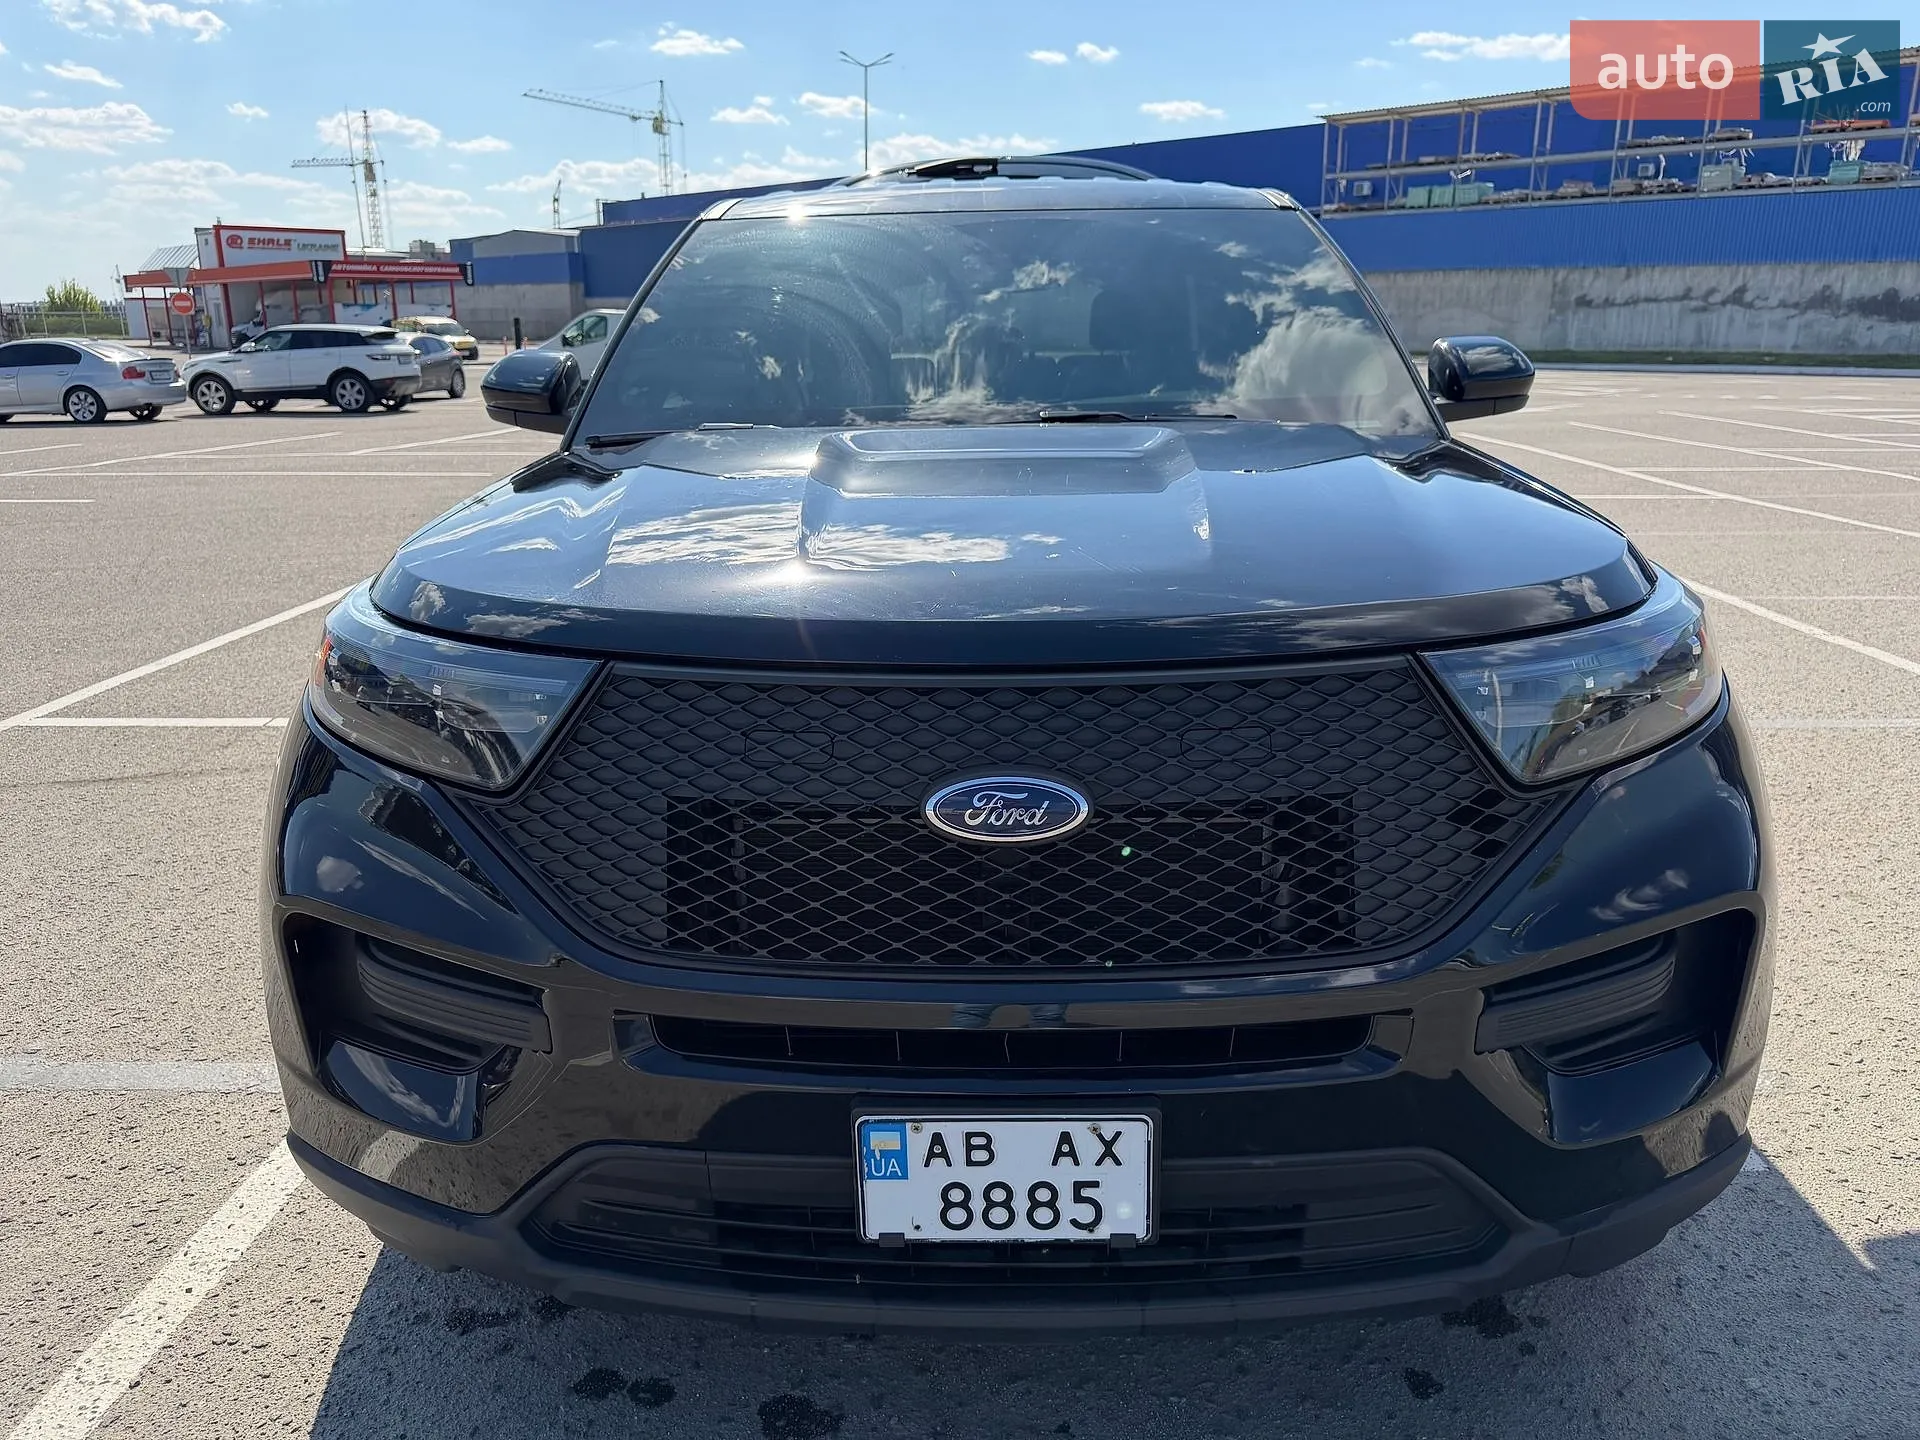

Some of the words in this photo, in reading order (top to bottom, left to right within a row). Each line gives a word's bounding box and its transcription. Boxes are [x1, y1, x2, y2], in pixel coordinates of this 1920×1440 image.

[247, 237, 293, 248] EHRLE
[964, 791, 1050, 826] Ford
[923, 1131, 996, 1168] AB
[1051, 1130, 1123, 1167] AX
[871, 1159, 902, 1177] UA
[939, 1180, 1103, 1231] 8885
